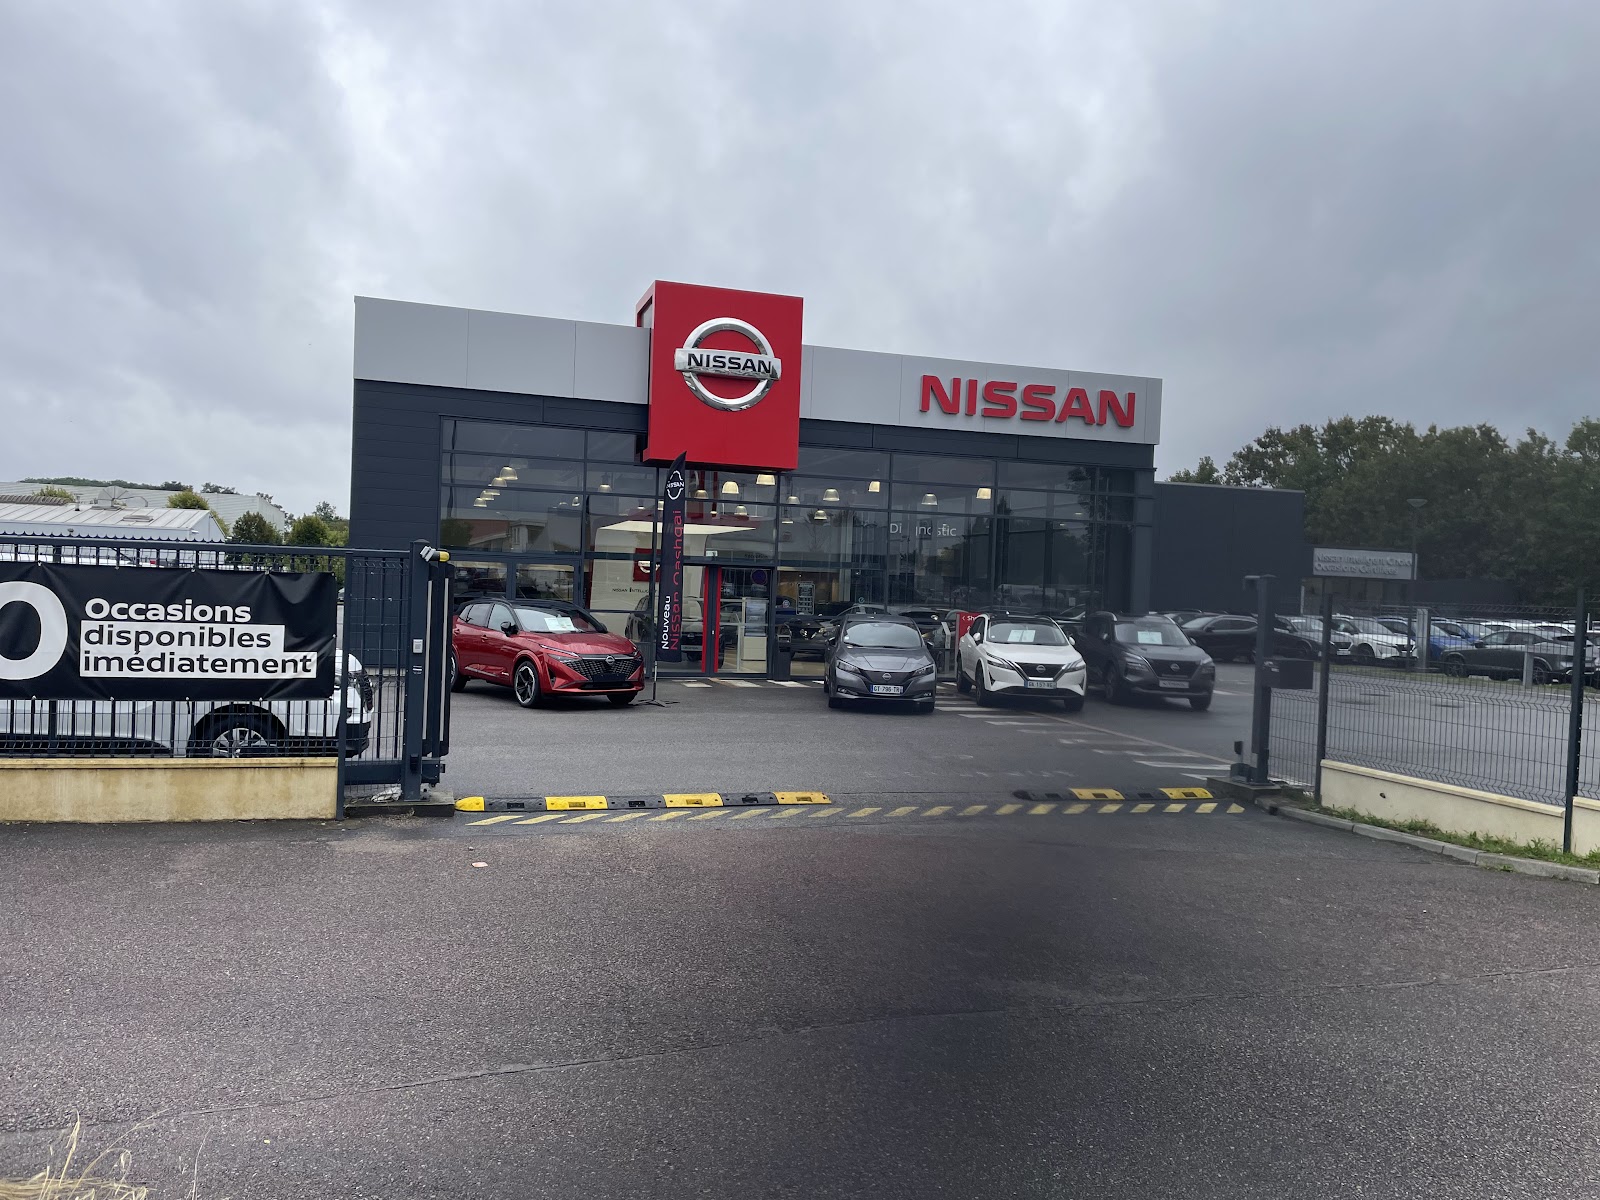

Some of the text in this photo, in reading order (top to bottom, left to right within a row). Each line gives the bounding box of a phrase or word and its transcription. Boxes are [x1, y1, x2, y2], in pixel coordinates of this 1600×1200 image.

[686, 352, 773, 375] NISSAN
[919, 374, 1136, 428] NISSAN
[665, 481, 685, 489] NISSAN
[84, 598, 251, 623] Occasions
[661, 595, 671, 650] Nouveau
[669, 592, 681, 650] Nissan
[84, 624, 271, 652] disponibles
[84, 650, 312, 674] imédiatement
